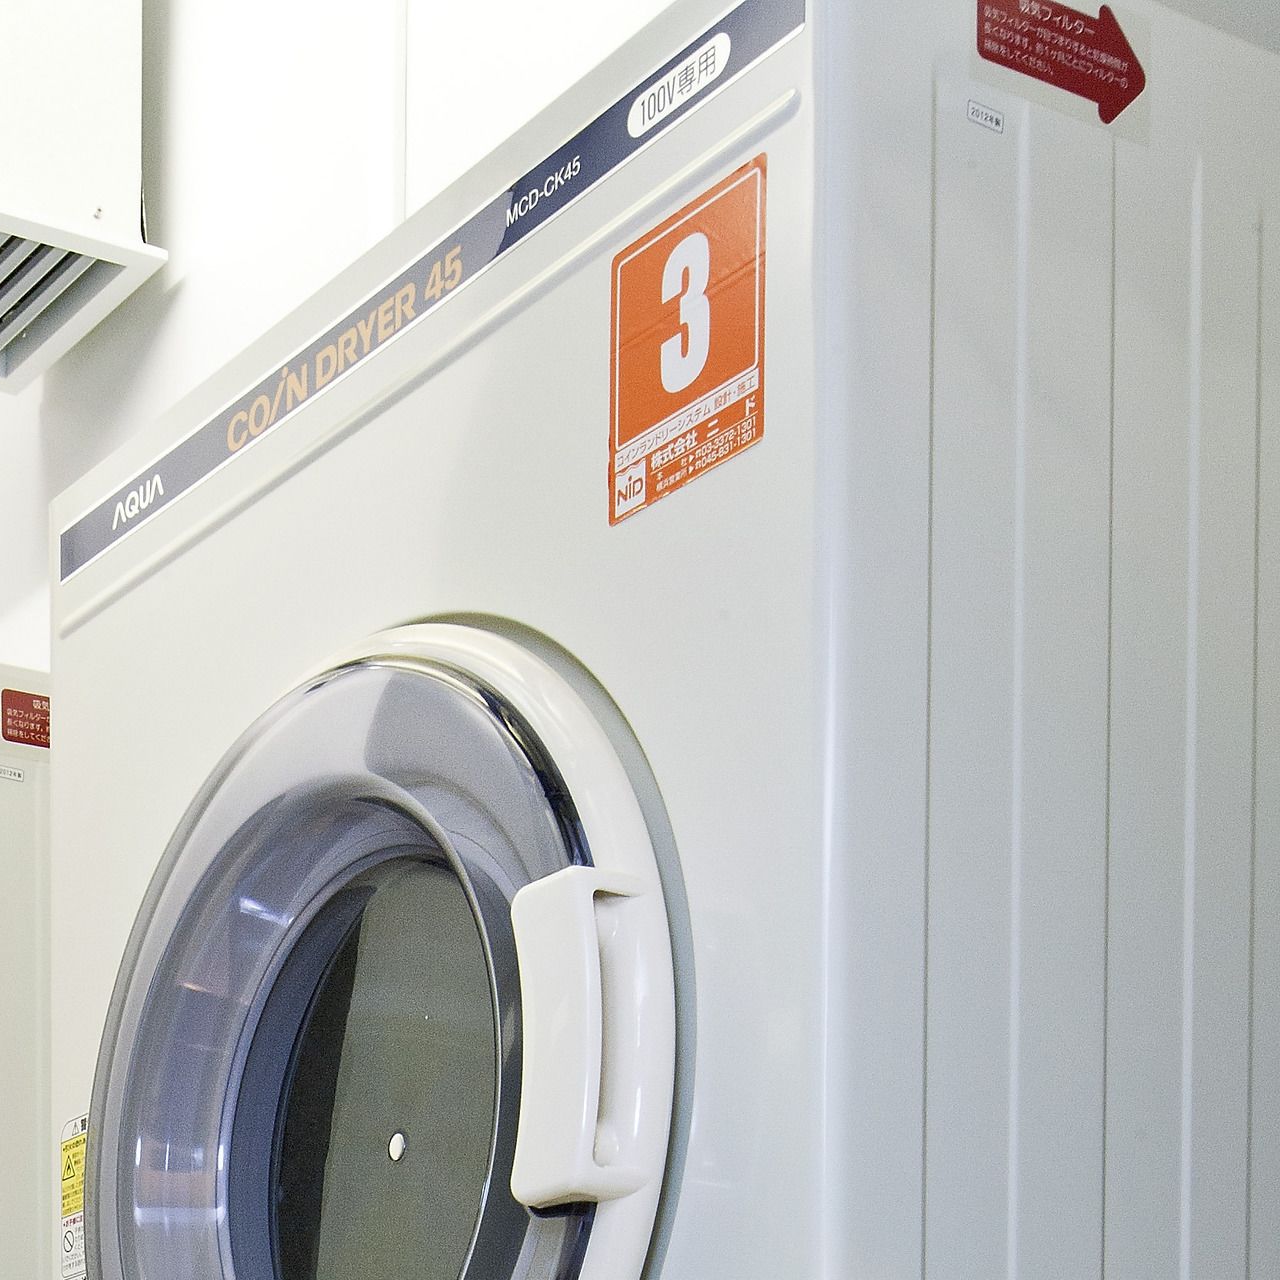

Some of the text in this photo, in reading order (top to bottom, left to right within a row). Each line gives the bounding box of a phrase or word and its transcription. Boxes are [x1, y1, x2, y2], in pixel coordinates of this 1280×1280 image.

[641, 44, 716, 126] 100V専用
[505, 156, 581, 227] MCD-CK45
[316, 281, 417, 389] DRYER
[424, 244, 463, 300] 45
[660, 231, 712, 392] 3
[111, 474, 165, 531] AQUA
